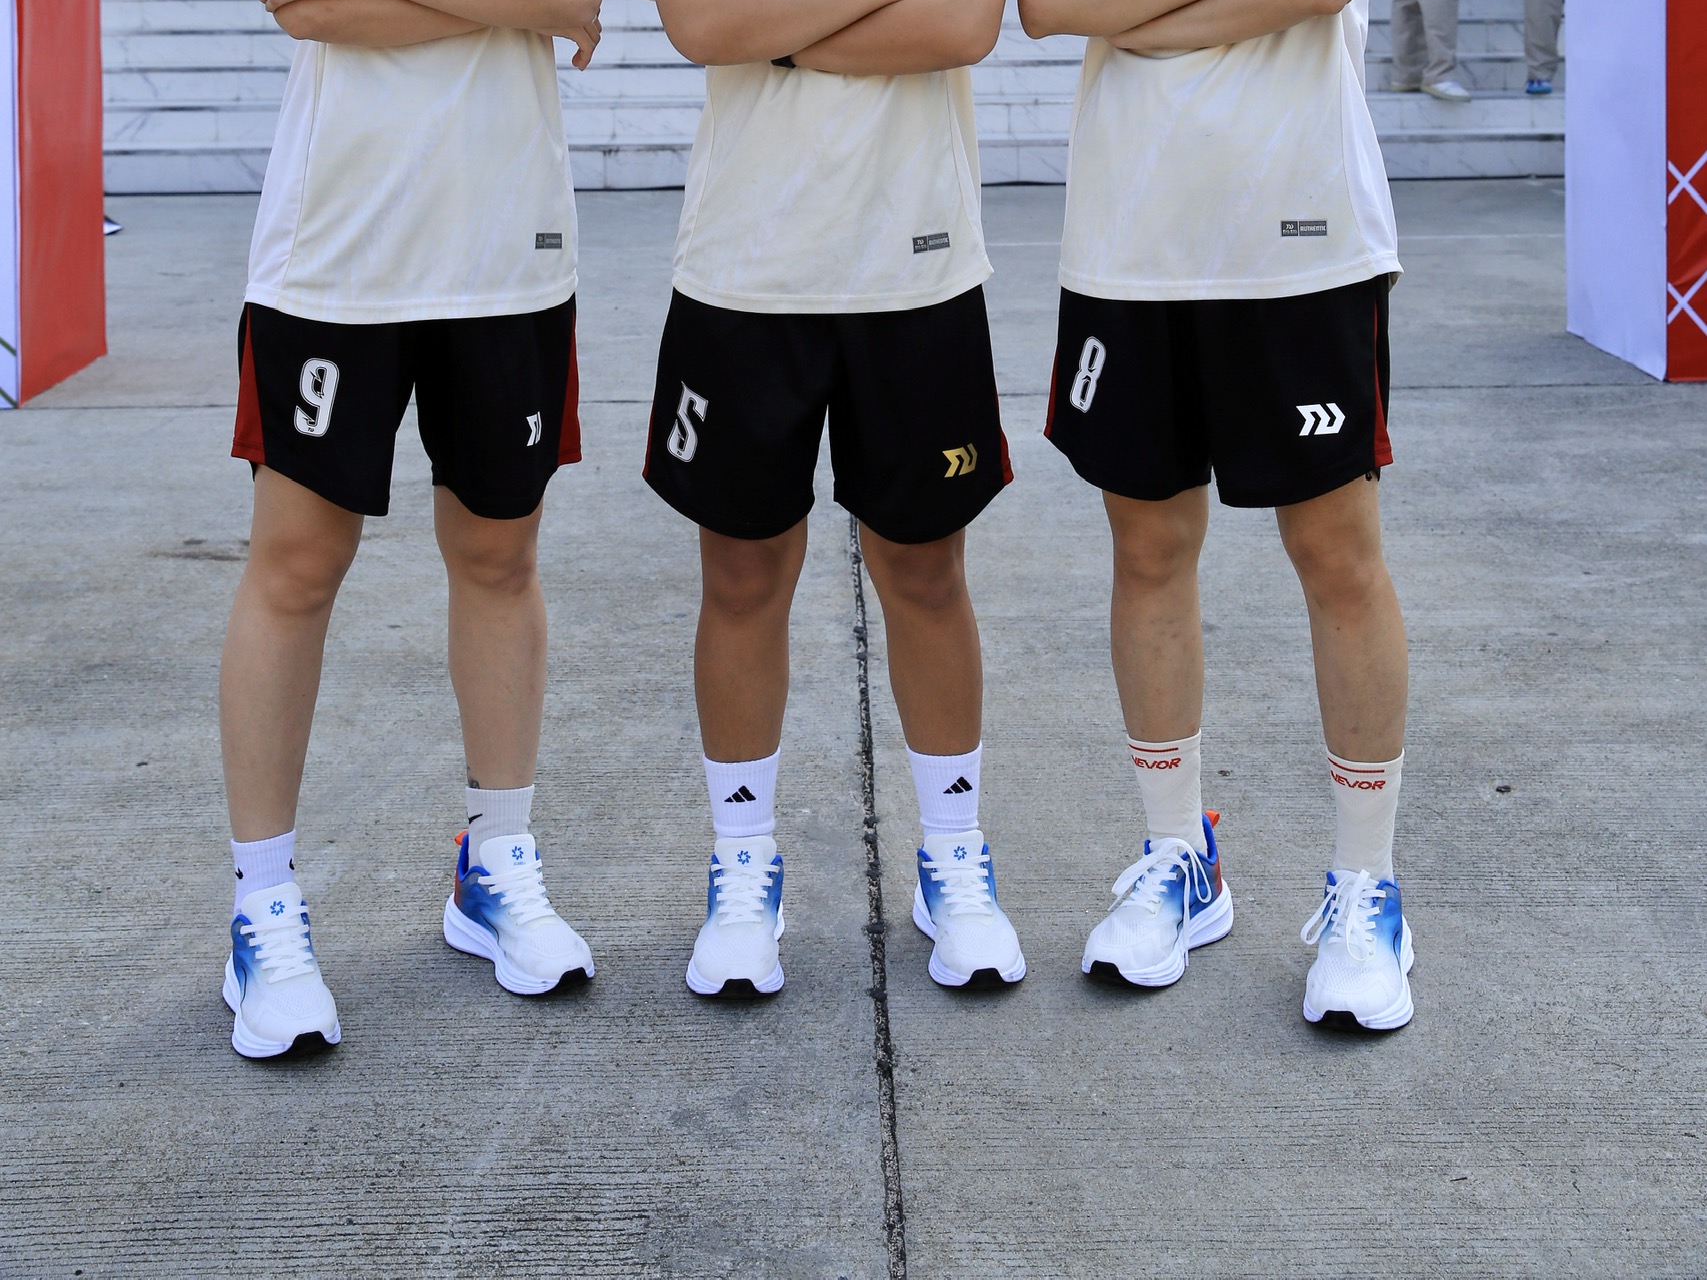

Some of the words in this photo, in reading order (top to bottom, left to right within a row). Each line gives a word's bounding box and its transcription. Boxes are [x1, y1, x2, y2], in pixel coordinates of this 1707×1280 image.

[293, 357, 340, 438] 9
[1069, 335, 1107, 414] 8
[667, 380, 709, 463] 5
